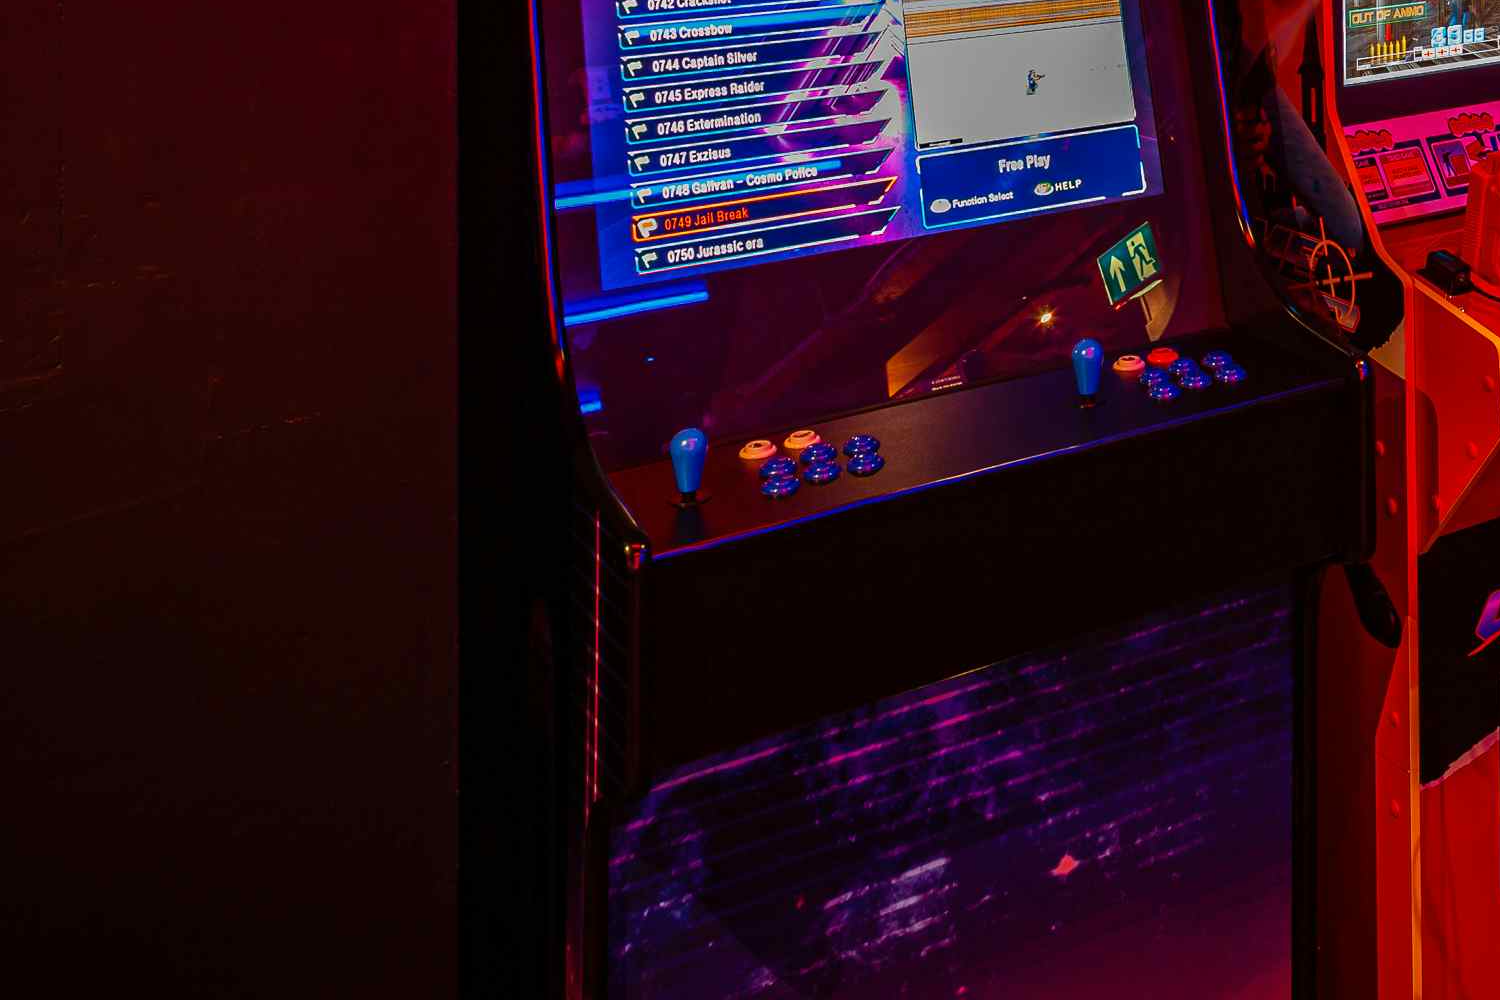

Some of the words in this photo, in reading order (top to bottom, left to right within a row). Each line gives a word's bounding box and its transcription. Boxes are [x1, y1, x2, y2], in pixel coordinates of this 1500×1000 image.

[1352, 12, 1373, 25] OUT
[1376, 9, 1391, 20] OF
[1393, 5, 1424, 18] AMMO
[650, 28, 678, 42] 0743
[680, 23, 733, 39] Crossbow
[652, 59, 680, 73] 0744
[682, 53, 724, 71] Captain
[726, 51, 757, 65] Silver
[654, 90, 682, 104] 0745
[684, 84, 728, 102] Express
[729, 80, 765, 95] Raider
[657, 121, 685, 136] 0746
[687, 111, 762, 133] Extermination
[660, 153, 687, 167] 0747
[689, 146, 731, 164] Exzisus
[998, 157, 1024, 174] Free
[1026, 153, 1051, 171] Play
[662, 184, 690, 199] 0748
[691, 179, 735, 196] Galivan
[746, 172, 783, 187] Cosmo
[785, 166, 818, 181] Police
[1054, 178, 1082, 193] HELP
[952, 194, 987, 209] Function
[988, 191, 1014, 203] Select
[664, 216, 691, 231] 0749
[693, 212, 715, 227] Jail
[716, 208, 749, 223] Break
[667, 248, 694, 264] 0750
[696, 240, 744, 260] Jurassic
[745, 238, 764, 250] era
